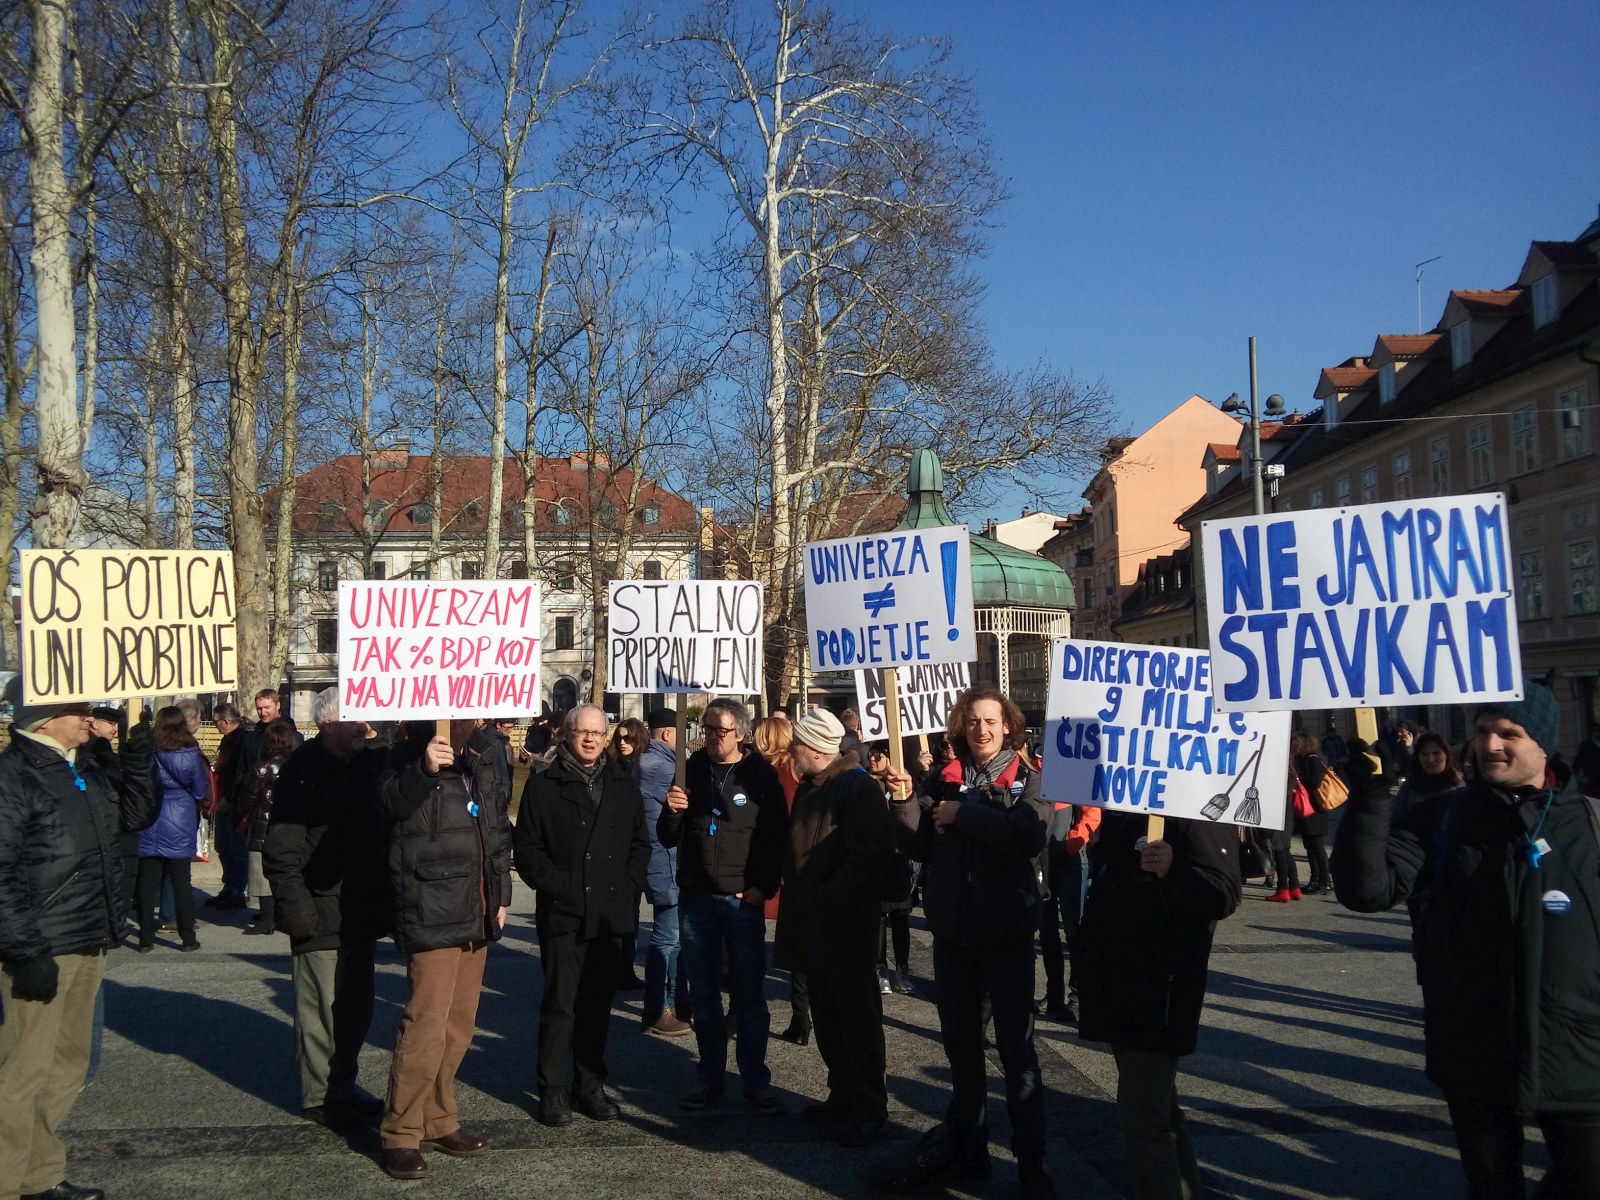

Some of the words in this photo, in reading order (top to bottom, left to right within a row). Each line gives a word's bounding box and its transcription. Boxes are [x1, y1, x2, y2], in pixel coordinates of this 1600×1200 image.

[810, 535, 930, 585] UNIVERZA
[1219, 520, 1301, 614] NE
[29, 550, 81, 624] OŠ
[350, 586, 532, 629] UNIVERZAM
[612, 584, 762, 636] STALNO
[30, 627, 84, 697] UNI
[103, 623, 236, 693] DROBTINE
[349, 636, 402, 672] TAK
[410, 636, 434, 669] %
[440, 636, 491, 670] BDP
[495, 636, 540, 668] KOT
[612, 636, 758, 692] PRIPRAVLJENI
[816, 620, 931, 667] PODJETJE
[1218, 597, 1514, 701] STAVKAM
[345, 676, 406, 708] MAJI
[411, 675, 440, 707] NA
[448, 672, 535, 709] VOLITVAH
[866, 690, 964, 736] SAVKA
[1098, 686, 1122, 722] 9
[1056, 716, 1240, 776] ČISTILKAM
[1092, 763, 1168, 809] NOVE
